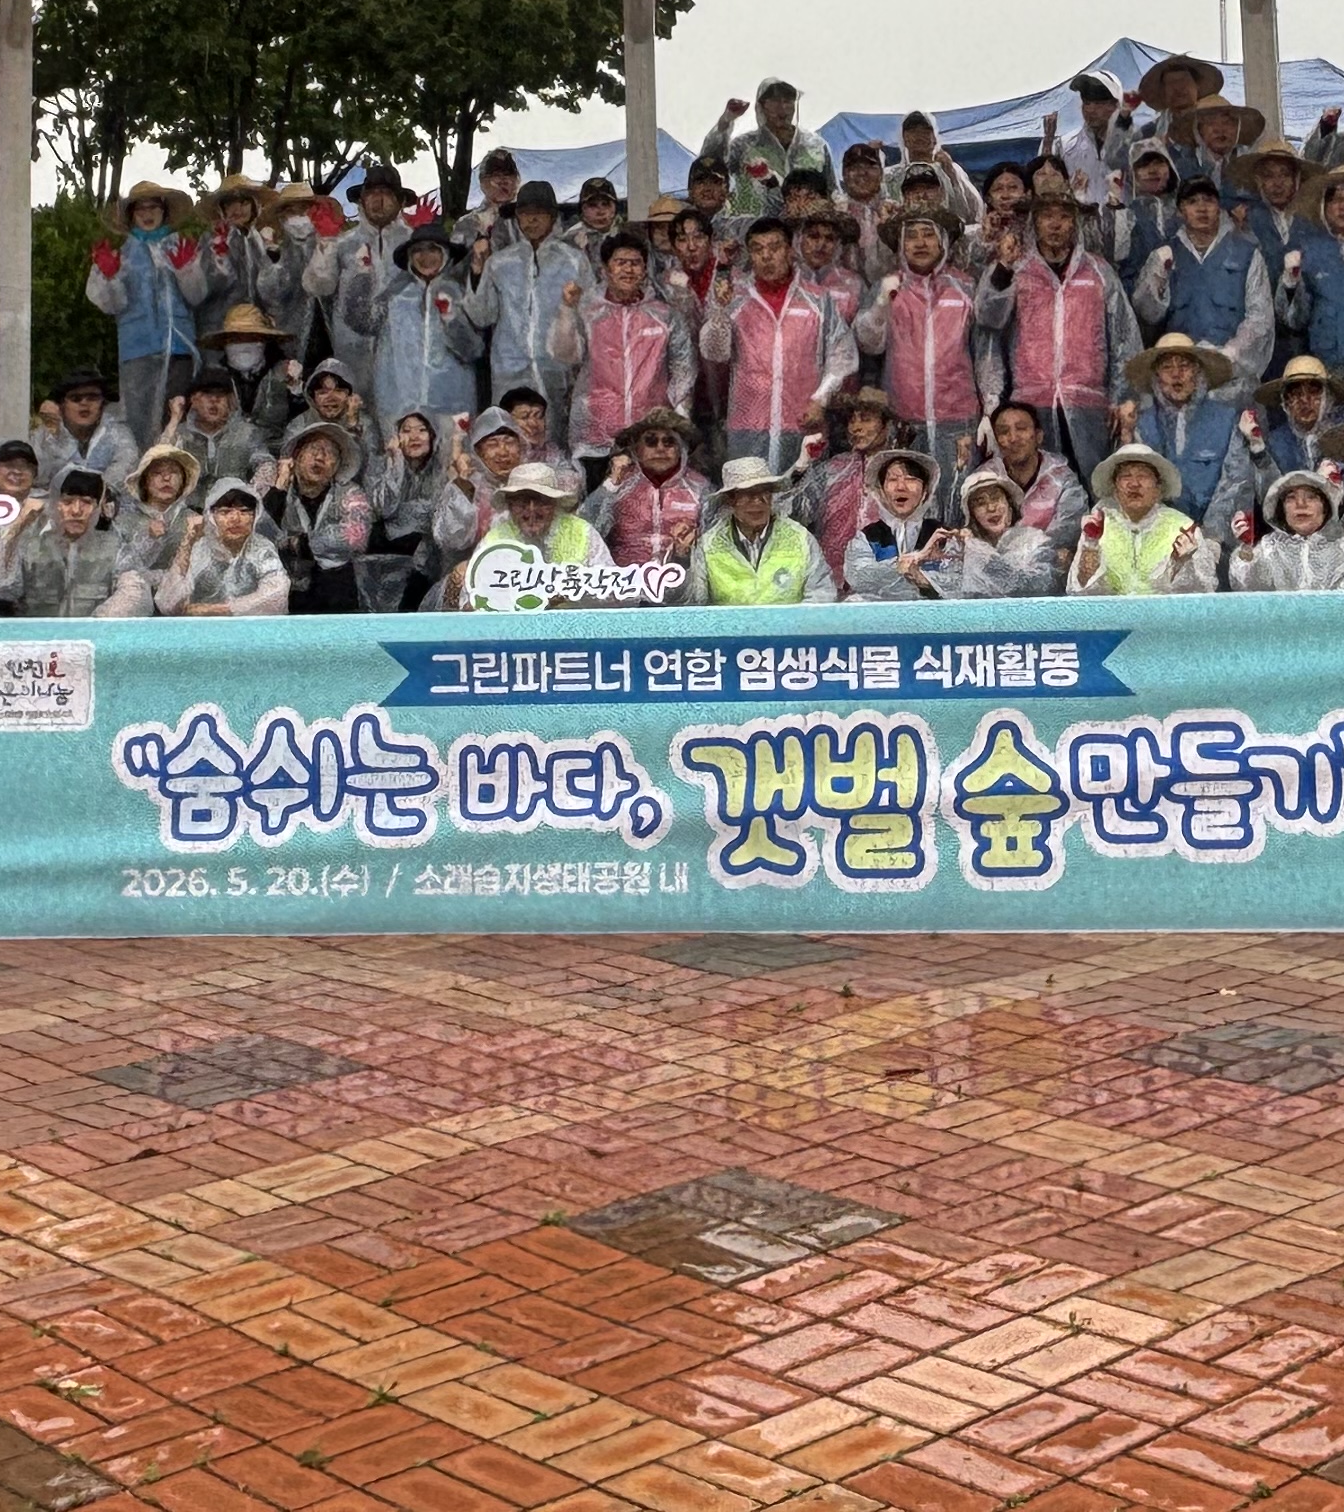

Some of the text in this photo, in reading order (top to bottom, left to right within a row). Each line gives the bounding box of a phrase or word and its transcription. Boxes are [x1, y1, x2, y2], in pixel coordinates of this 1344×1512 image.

[489, 565, 636, 597] 그린상륙작전
[430, 642, 1081, 692] 그린파트너 연합 염생식물 식재활동
[459, 742, 662, 839] 바다,
[682, 722, 927, 878] 갯벌
[954, 720, 1070, 878] 숲
[385, 863, 402, 898] /
[413, 862, 651, 895] 소래습지생태공원
[660, 862, 688, 894] 내
